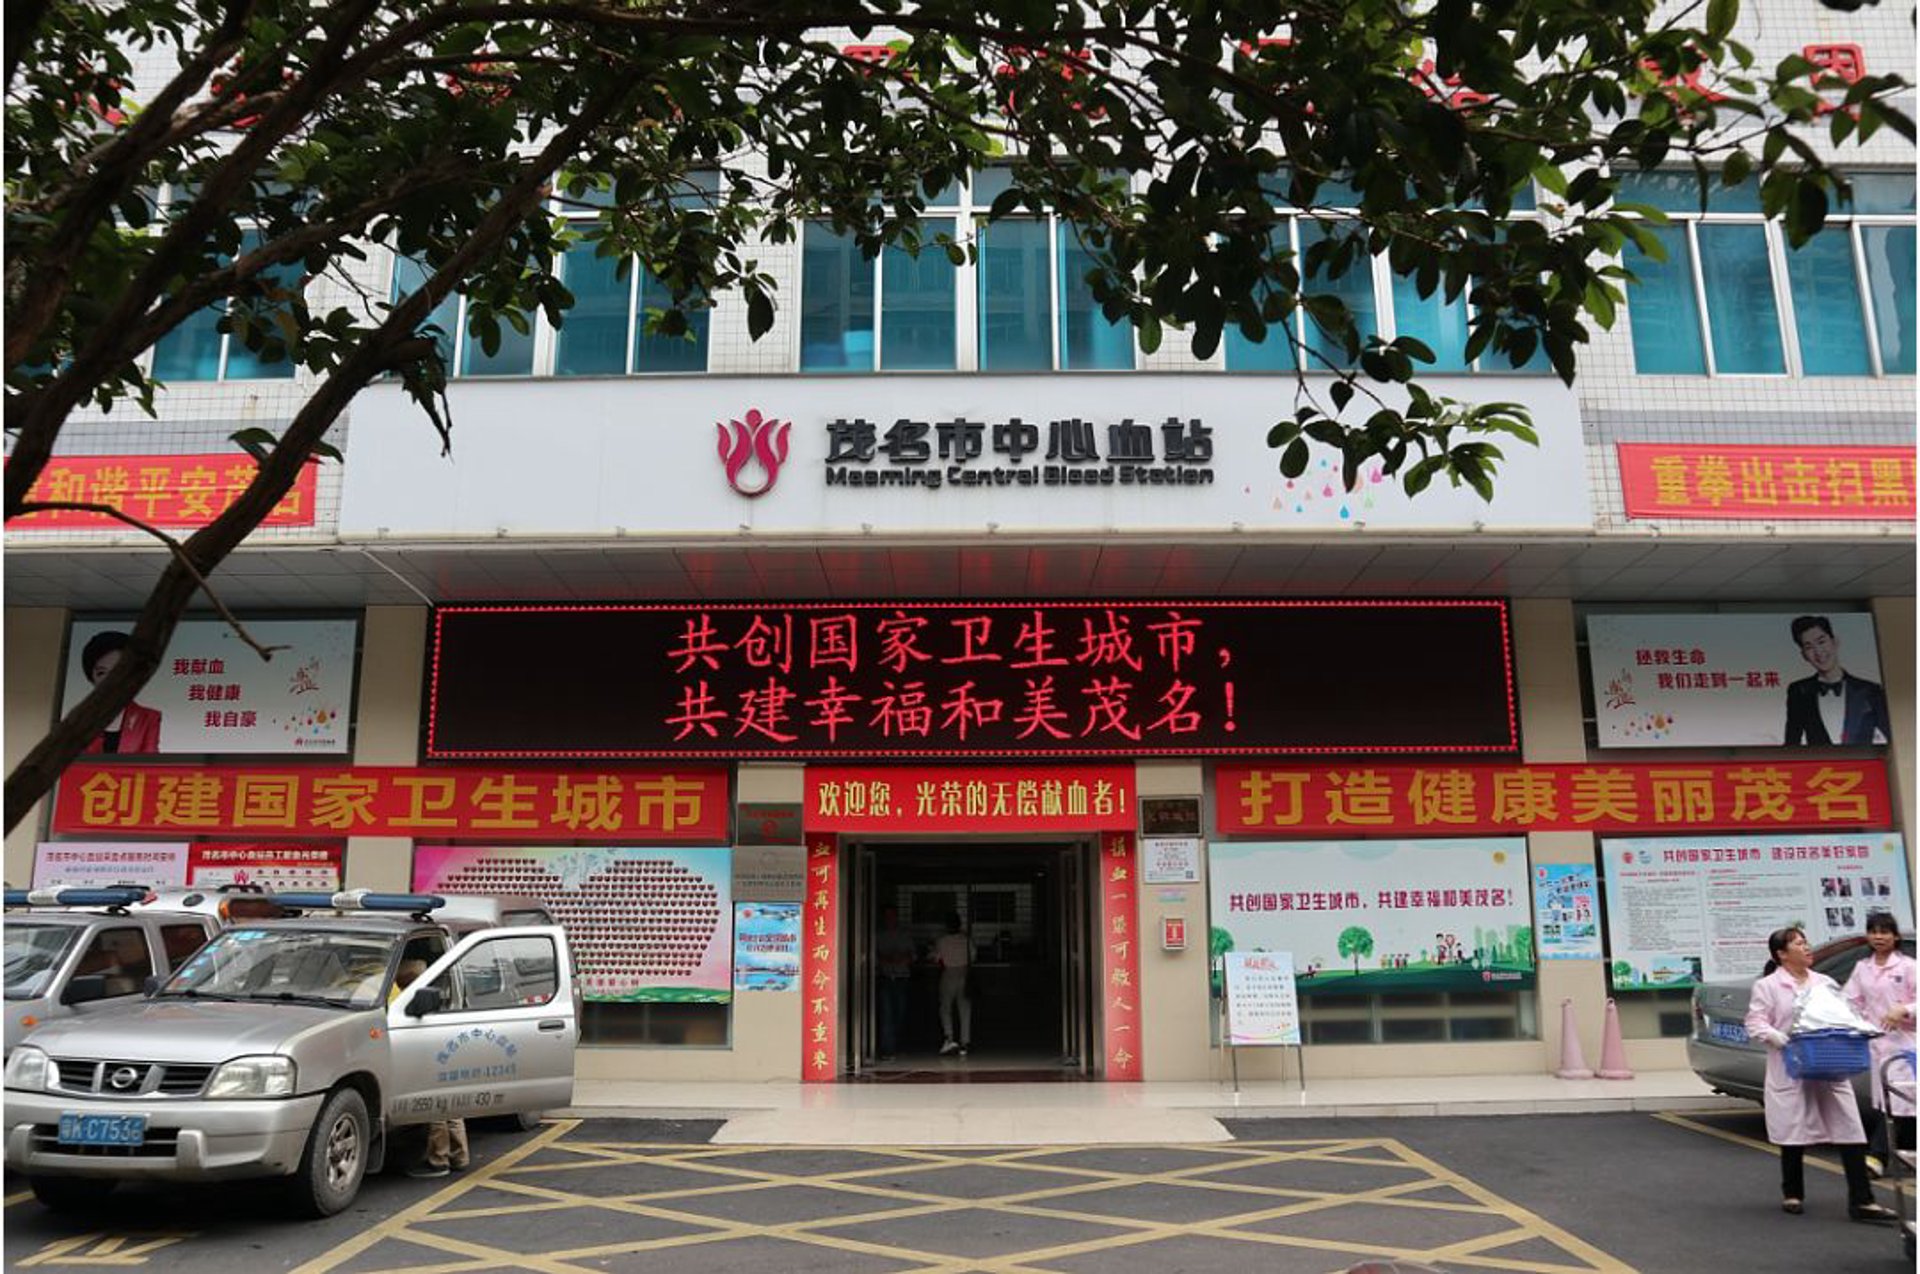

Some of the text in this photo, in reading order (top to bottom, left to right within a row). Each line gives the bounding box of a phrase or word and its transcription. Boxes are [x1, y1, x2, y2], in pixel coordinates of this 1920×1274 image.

[825, 417, 1213, 464] 茂名市中心血站
[825, 465, 1213, 489] Maoming Central Blood Station
[1650, 454, 1916, 507] 重拳出击扫黑
[667, 611, 1232, 673] 共创国家卫生城市,
[1636, 649, 1706, 665] 拯救生命
[173, 659, 225, 675] 我献血
[1658, 672, 1781, 689] 我们走到一起来
[188, 684, 241, 701] 我健康
[204, 711, 257, 727] 我自豪
[665, 676, 1236, 743] 共建幸福和美茂名!
[80, 771, 706, 831] 创建国家卫生城市
[818, 778, 1126, 817] 欢迎您,光荣的无偿献血者!
[1240, 767, 1871, 825] 打造健康美丽茂名
[1663, 848, 1761, 863] 共创国家卫生城市
